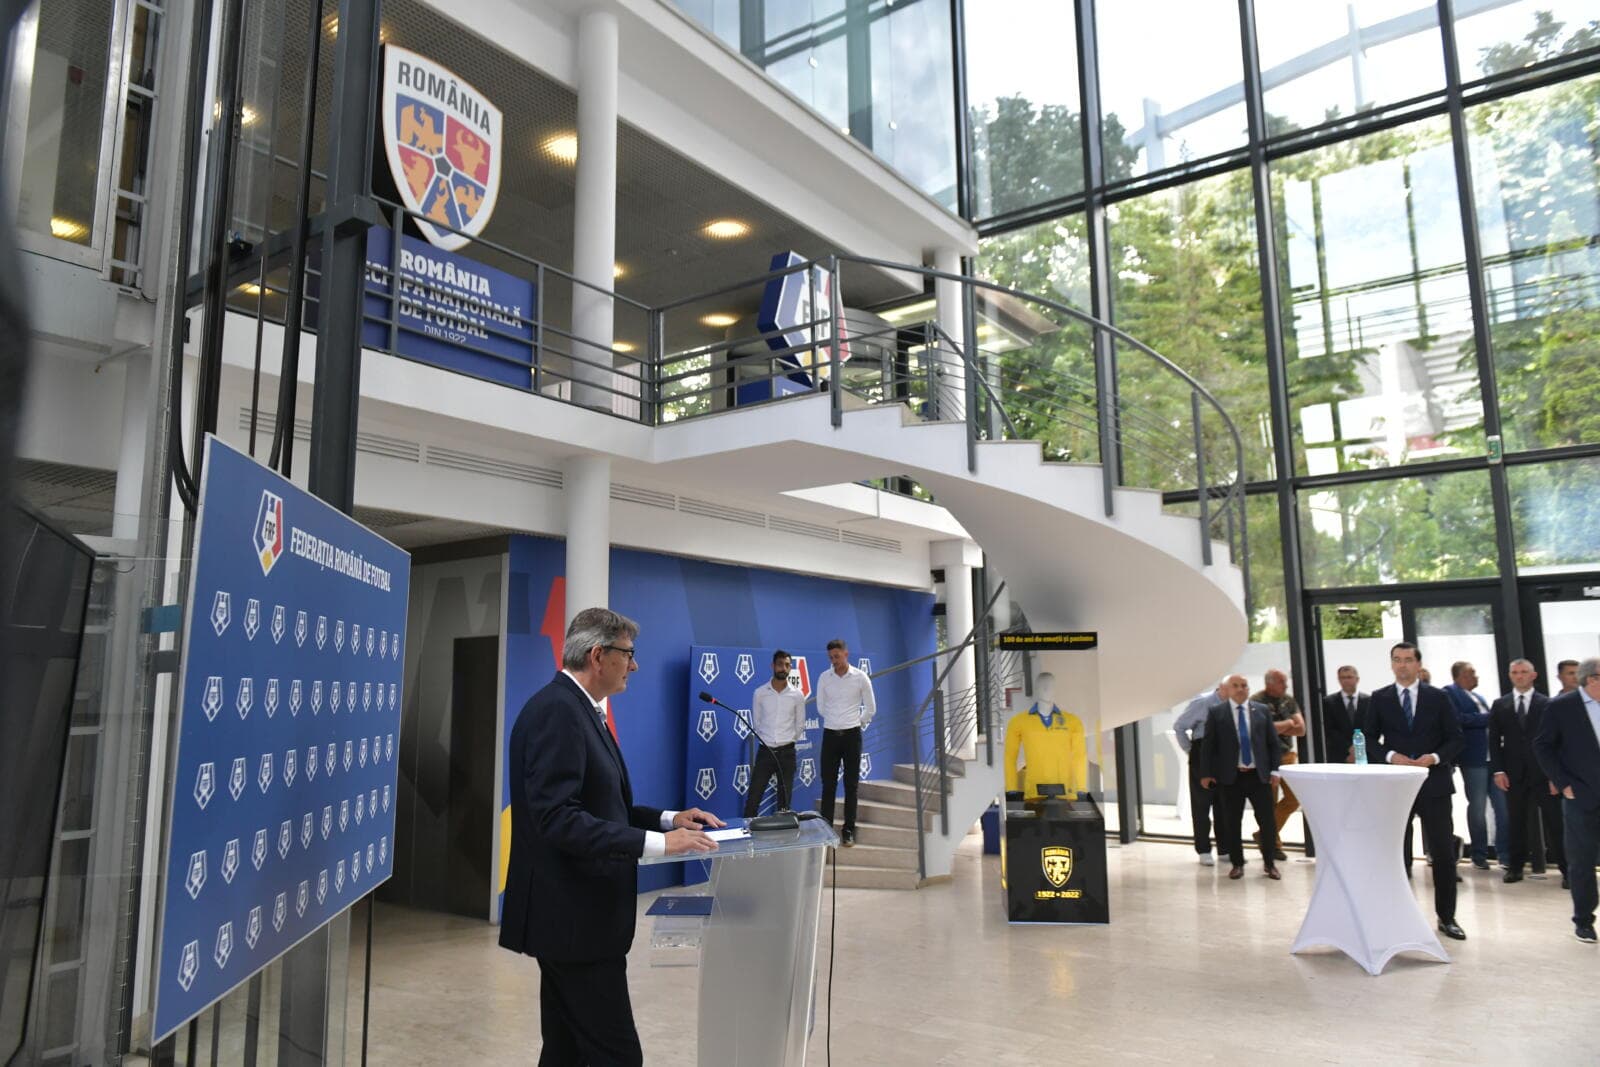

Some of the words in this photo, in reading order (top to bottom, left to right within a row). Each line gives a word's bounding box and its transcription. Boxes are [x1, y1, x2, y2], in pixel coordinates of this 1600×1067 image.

[397, 60, 491, 136] ROMÂNIA
[400, 248, 491, 297] ROMÂNIA
[290, 526, 334, 572] FEDERAȚIA
[334, 547, 363, 581] ROMÂNĂ
[362, 560, 373, 585] DE
[371, 565, 391, 592] FOTBAL
